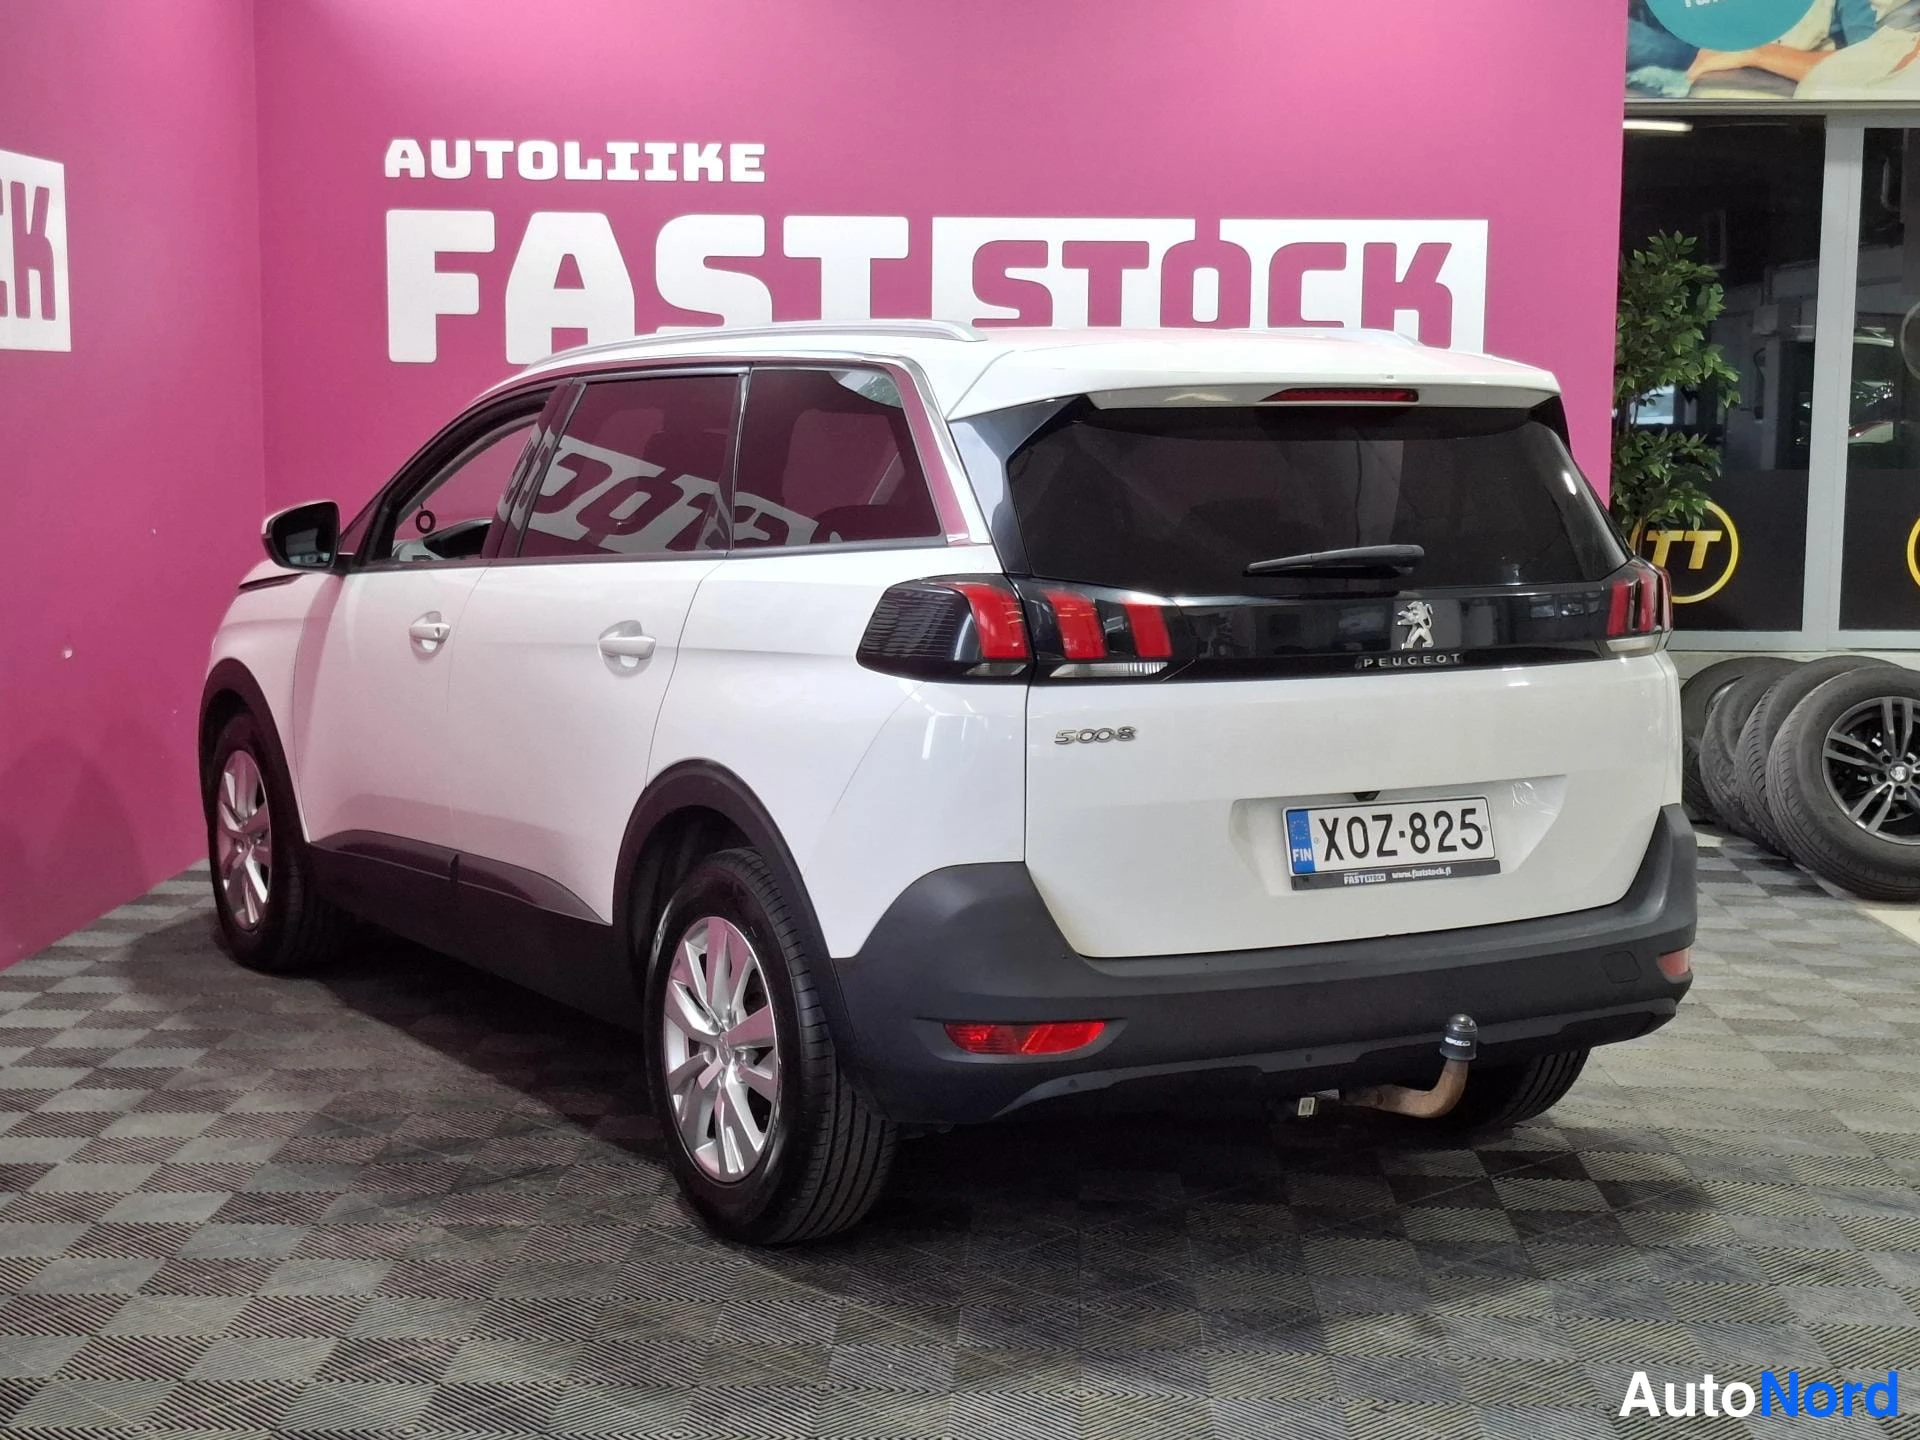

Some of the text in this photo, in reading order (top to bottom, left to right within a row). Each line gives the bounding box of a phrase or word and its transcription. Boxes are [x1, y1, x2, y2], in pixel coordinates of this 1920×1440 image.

[384, 138, 766, 184] AUTOLIIKE
[385, 208, 1453, 365] FAST STOCK
[1362, 652, 1463, 668] PEUGEOT
[1054, 725, 1138, 745] 5008
[1318, 807, 1484, 863] XOZ-825
[1292, 846, 1313, 863] FIN
